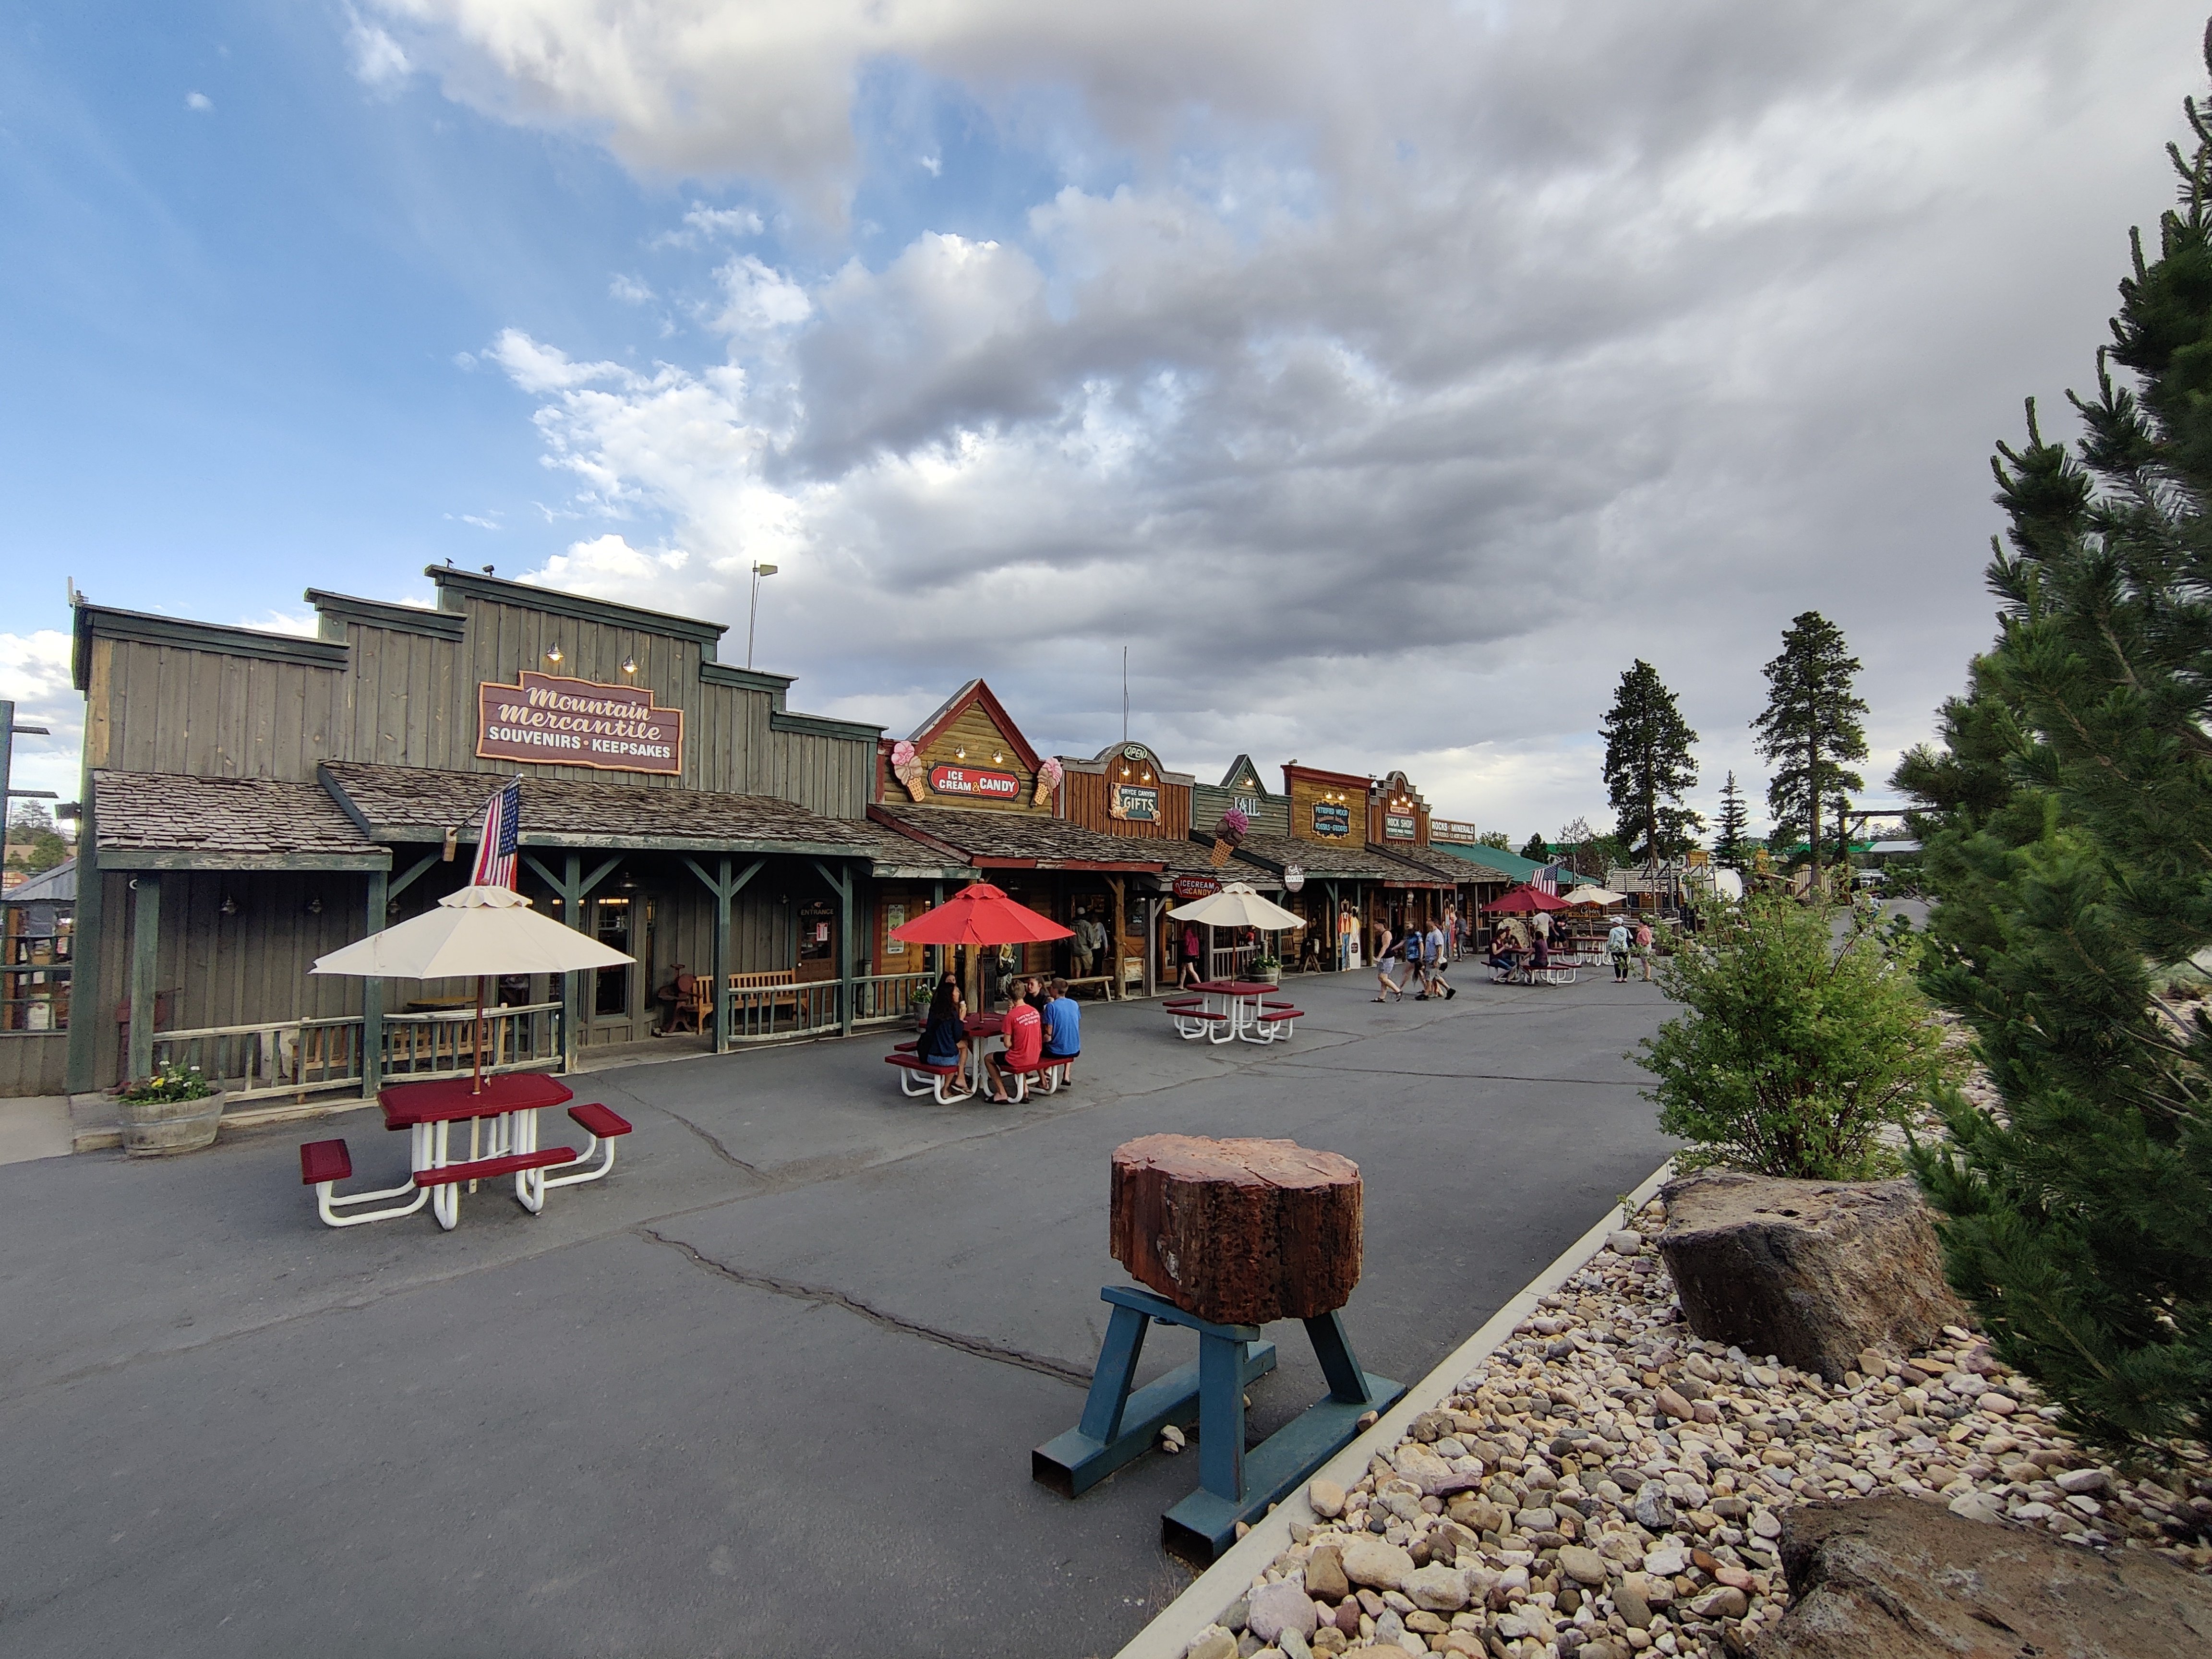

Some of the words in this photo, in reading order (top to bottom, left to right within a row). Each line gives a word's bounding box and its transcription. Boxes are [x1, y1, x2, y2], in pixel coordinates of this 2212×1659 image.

[526, 686, 651, 721] Mountain
[497, 703, 662, 741] Mercantile
[489, 725, 581, 750] SOUVENIRS
[591, 738, 671, 758] KEEPSAKES
[1126, 746, 1145, 759] OPEN
[948, 770, 964, 781] ICE
[939, 779, 972, 792] CREAM
[972, 781, 981, 793] &
[979, 778, 1016, 793] CANDY
[1121, 788, 1137, 796] BRYCE
[1138, 790, 1156, 798] CANYON
[1123, 796, 1154, 812] GIFTS
[1231, 796, 1261, 817] JAIL
[1315, 806, 1334, 815] PETRIFIED
[1315, 822, 1330, 830] FOSSILS
[1387, 817, 1400, 827] ROCK
[1400, 818, 1413, 829] SHOP
[1431, 821, 1448, 831] ROCKS
[1451, 823, 1474, 834] MINERALS
[1180, 879, 1214, 889] ICECREAM
[1285, 874, 1304, 883] COOKIES
[1189, 888, 1212, 896] CANDY
